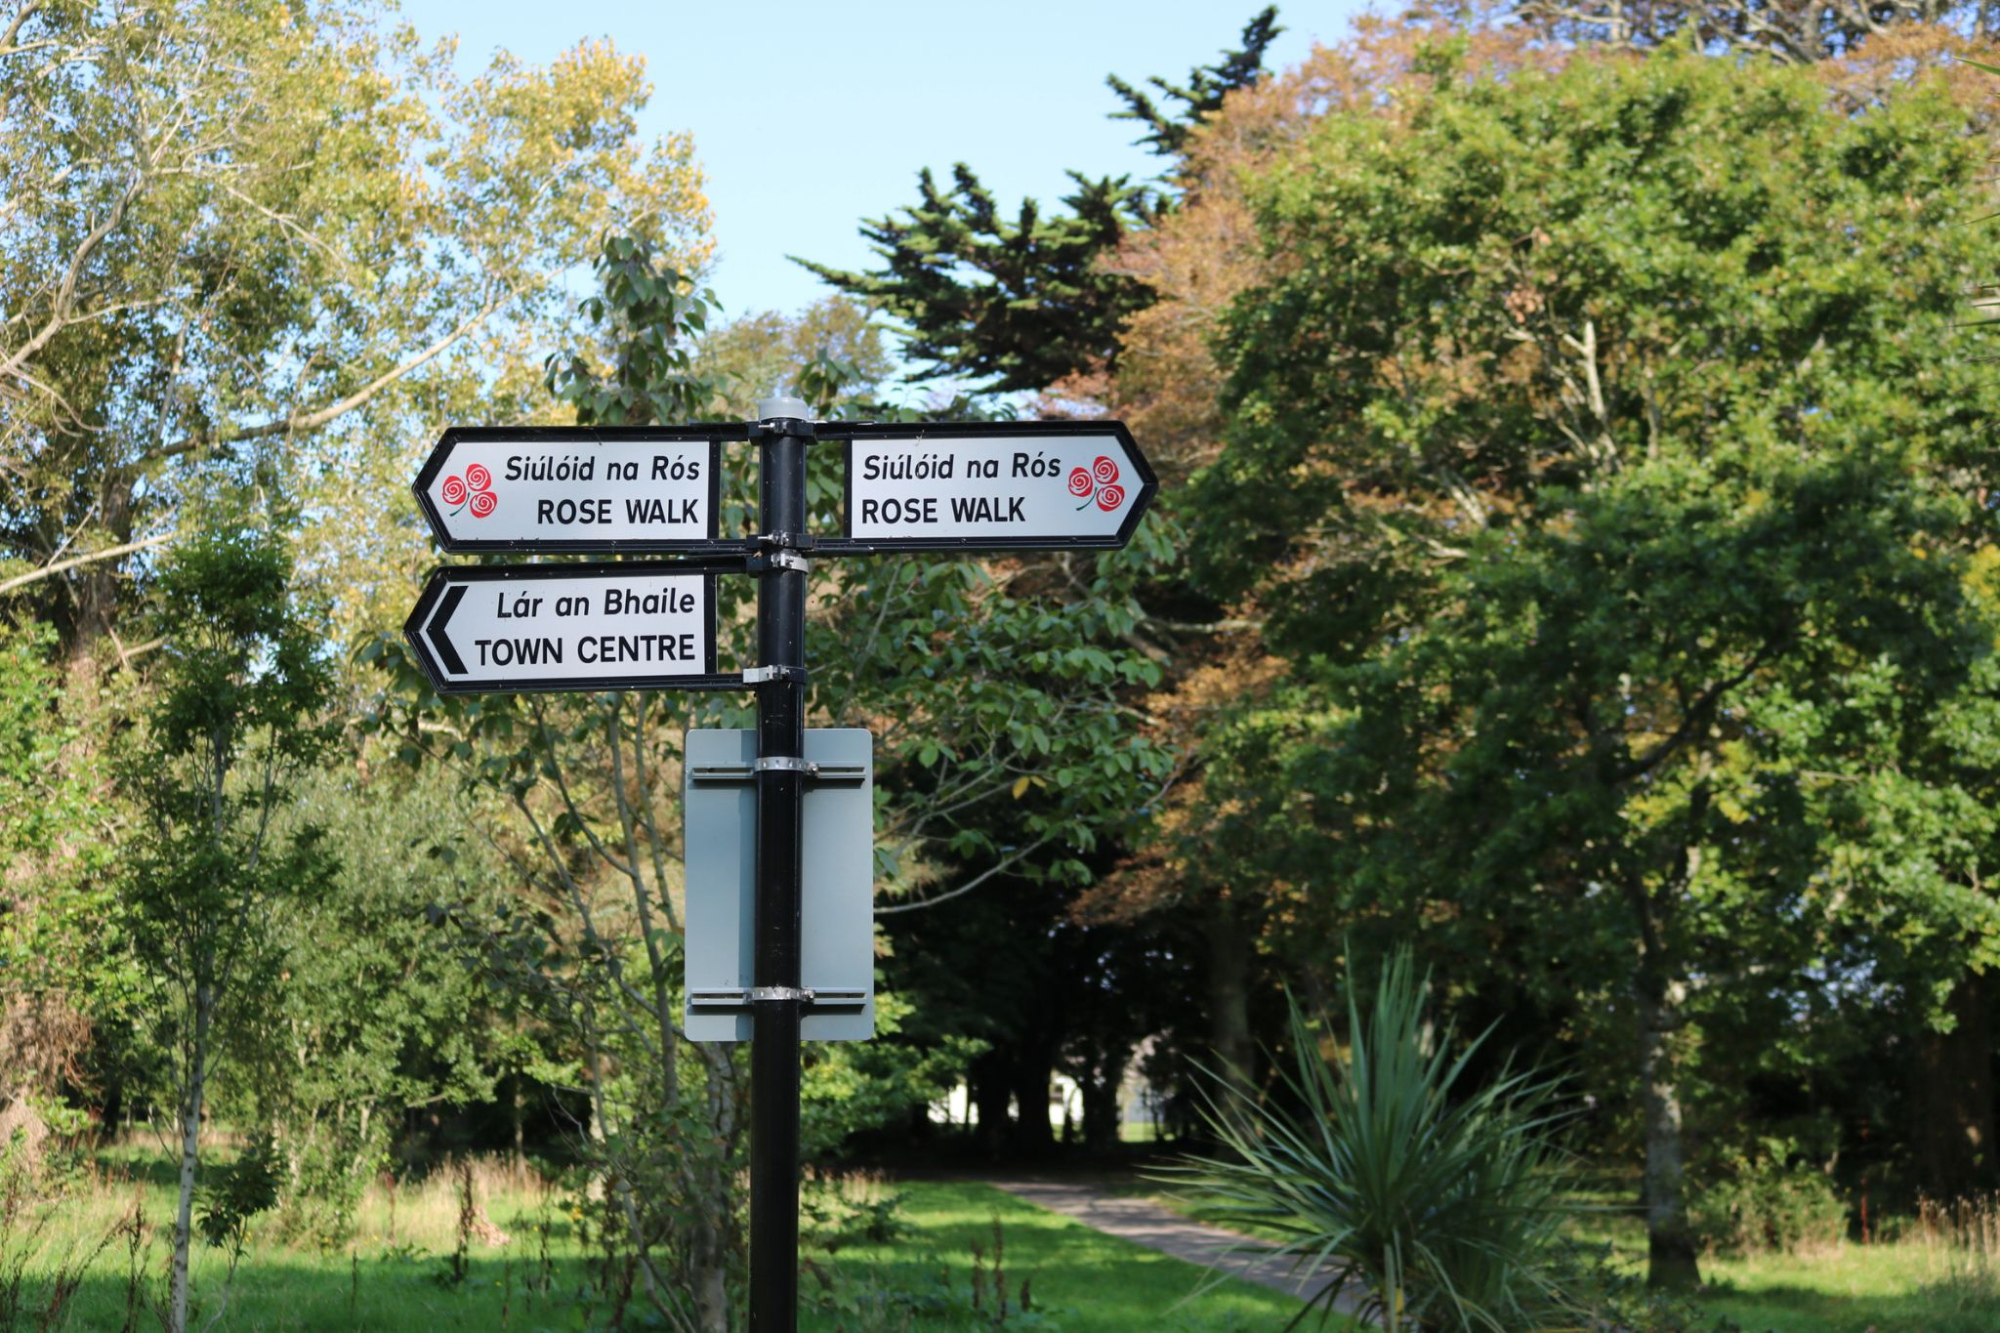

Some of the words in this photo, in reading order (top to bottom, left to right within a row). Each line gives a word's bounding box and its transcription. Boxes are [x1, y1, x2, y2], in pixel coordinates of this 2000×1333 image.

[504, 455, 596, 481] Siúlóid
[606, 461, 639, 481] na
[651, 454, 700, 481] Rós
[863, 453, 954, 480] Siúlóid
[966, 458, 999, 479] na
[1011, 451, 1061, 478] Rós
[537, 499, 613, 524] ROSE
[626, 499, 698, 524] WALK
[862, 498, 938, 524] ROSE
[951, 497, 1026, 523] WALK
[497, 590, 543, 619] Lár
[555, 596, 590, 617] an
[603, 588, 695, 615] Bhaile
[474, 637, 563, 666] TOWN
[577, 634, 696, 663] CENTRE
